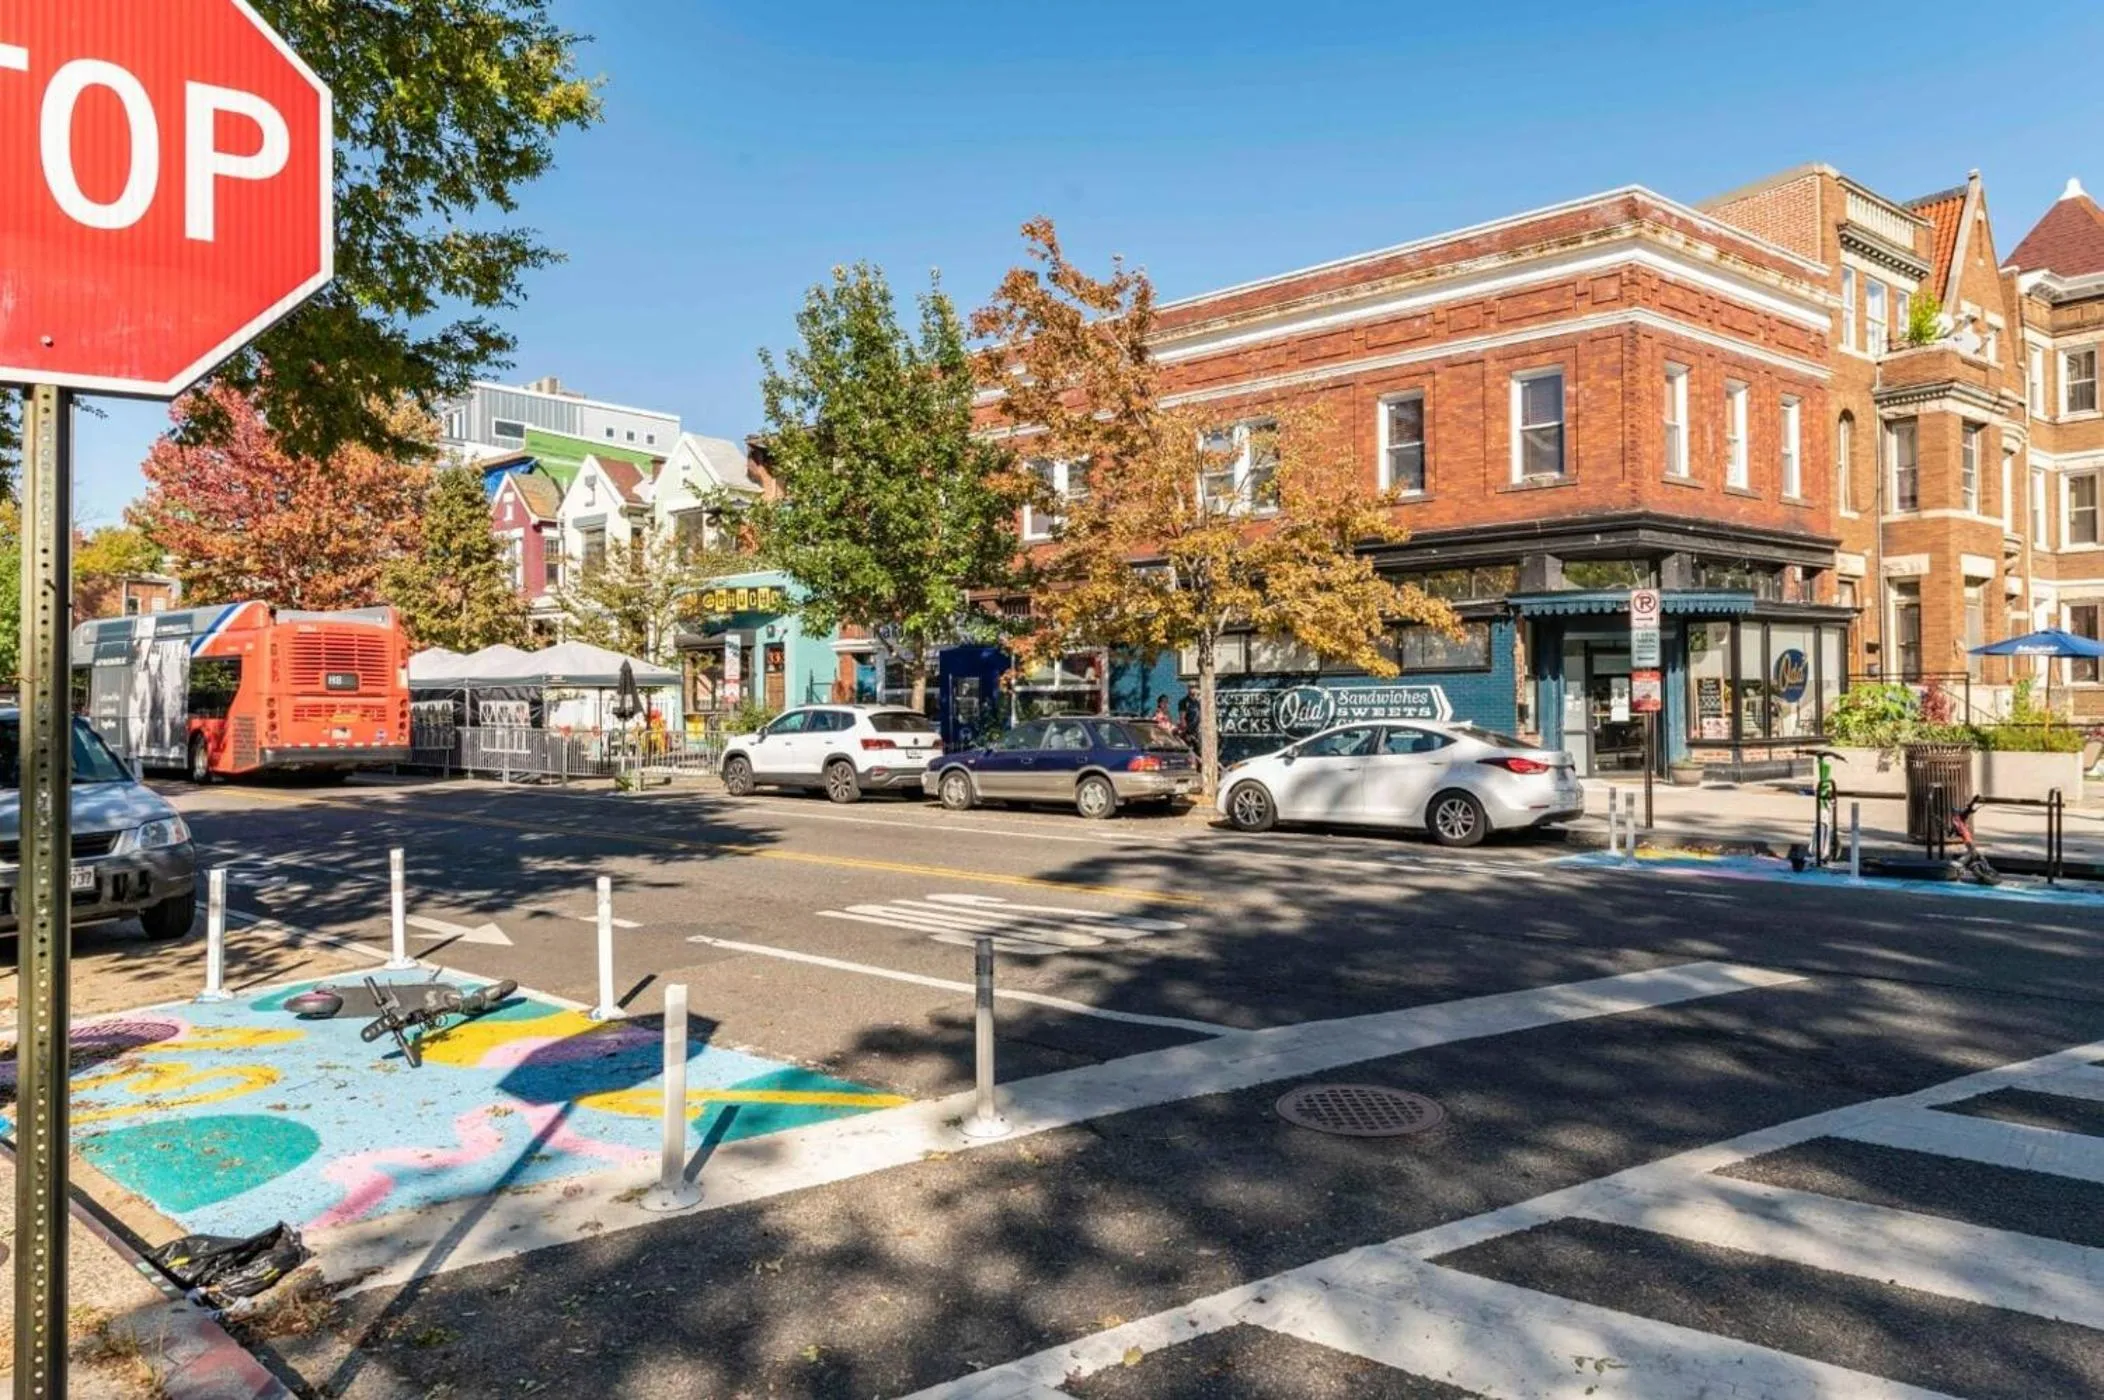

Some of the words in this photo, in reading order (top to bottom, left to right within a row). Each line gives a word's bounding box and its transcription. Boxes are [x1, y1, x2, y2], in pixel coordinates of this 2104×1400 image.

[0, 42, 291, 243] OP
[1215, 693, 1271, 705] OCERIES
[1337, 689, 1429, 705] Sandwiches
[1279, 690, 1324, 729] Odd
[1336, 706, 1432, 717] SWEETS
[1218, 717, 1272, 732] ACKS
